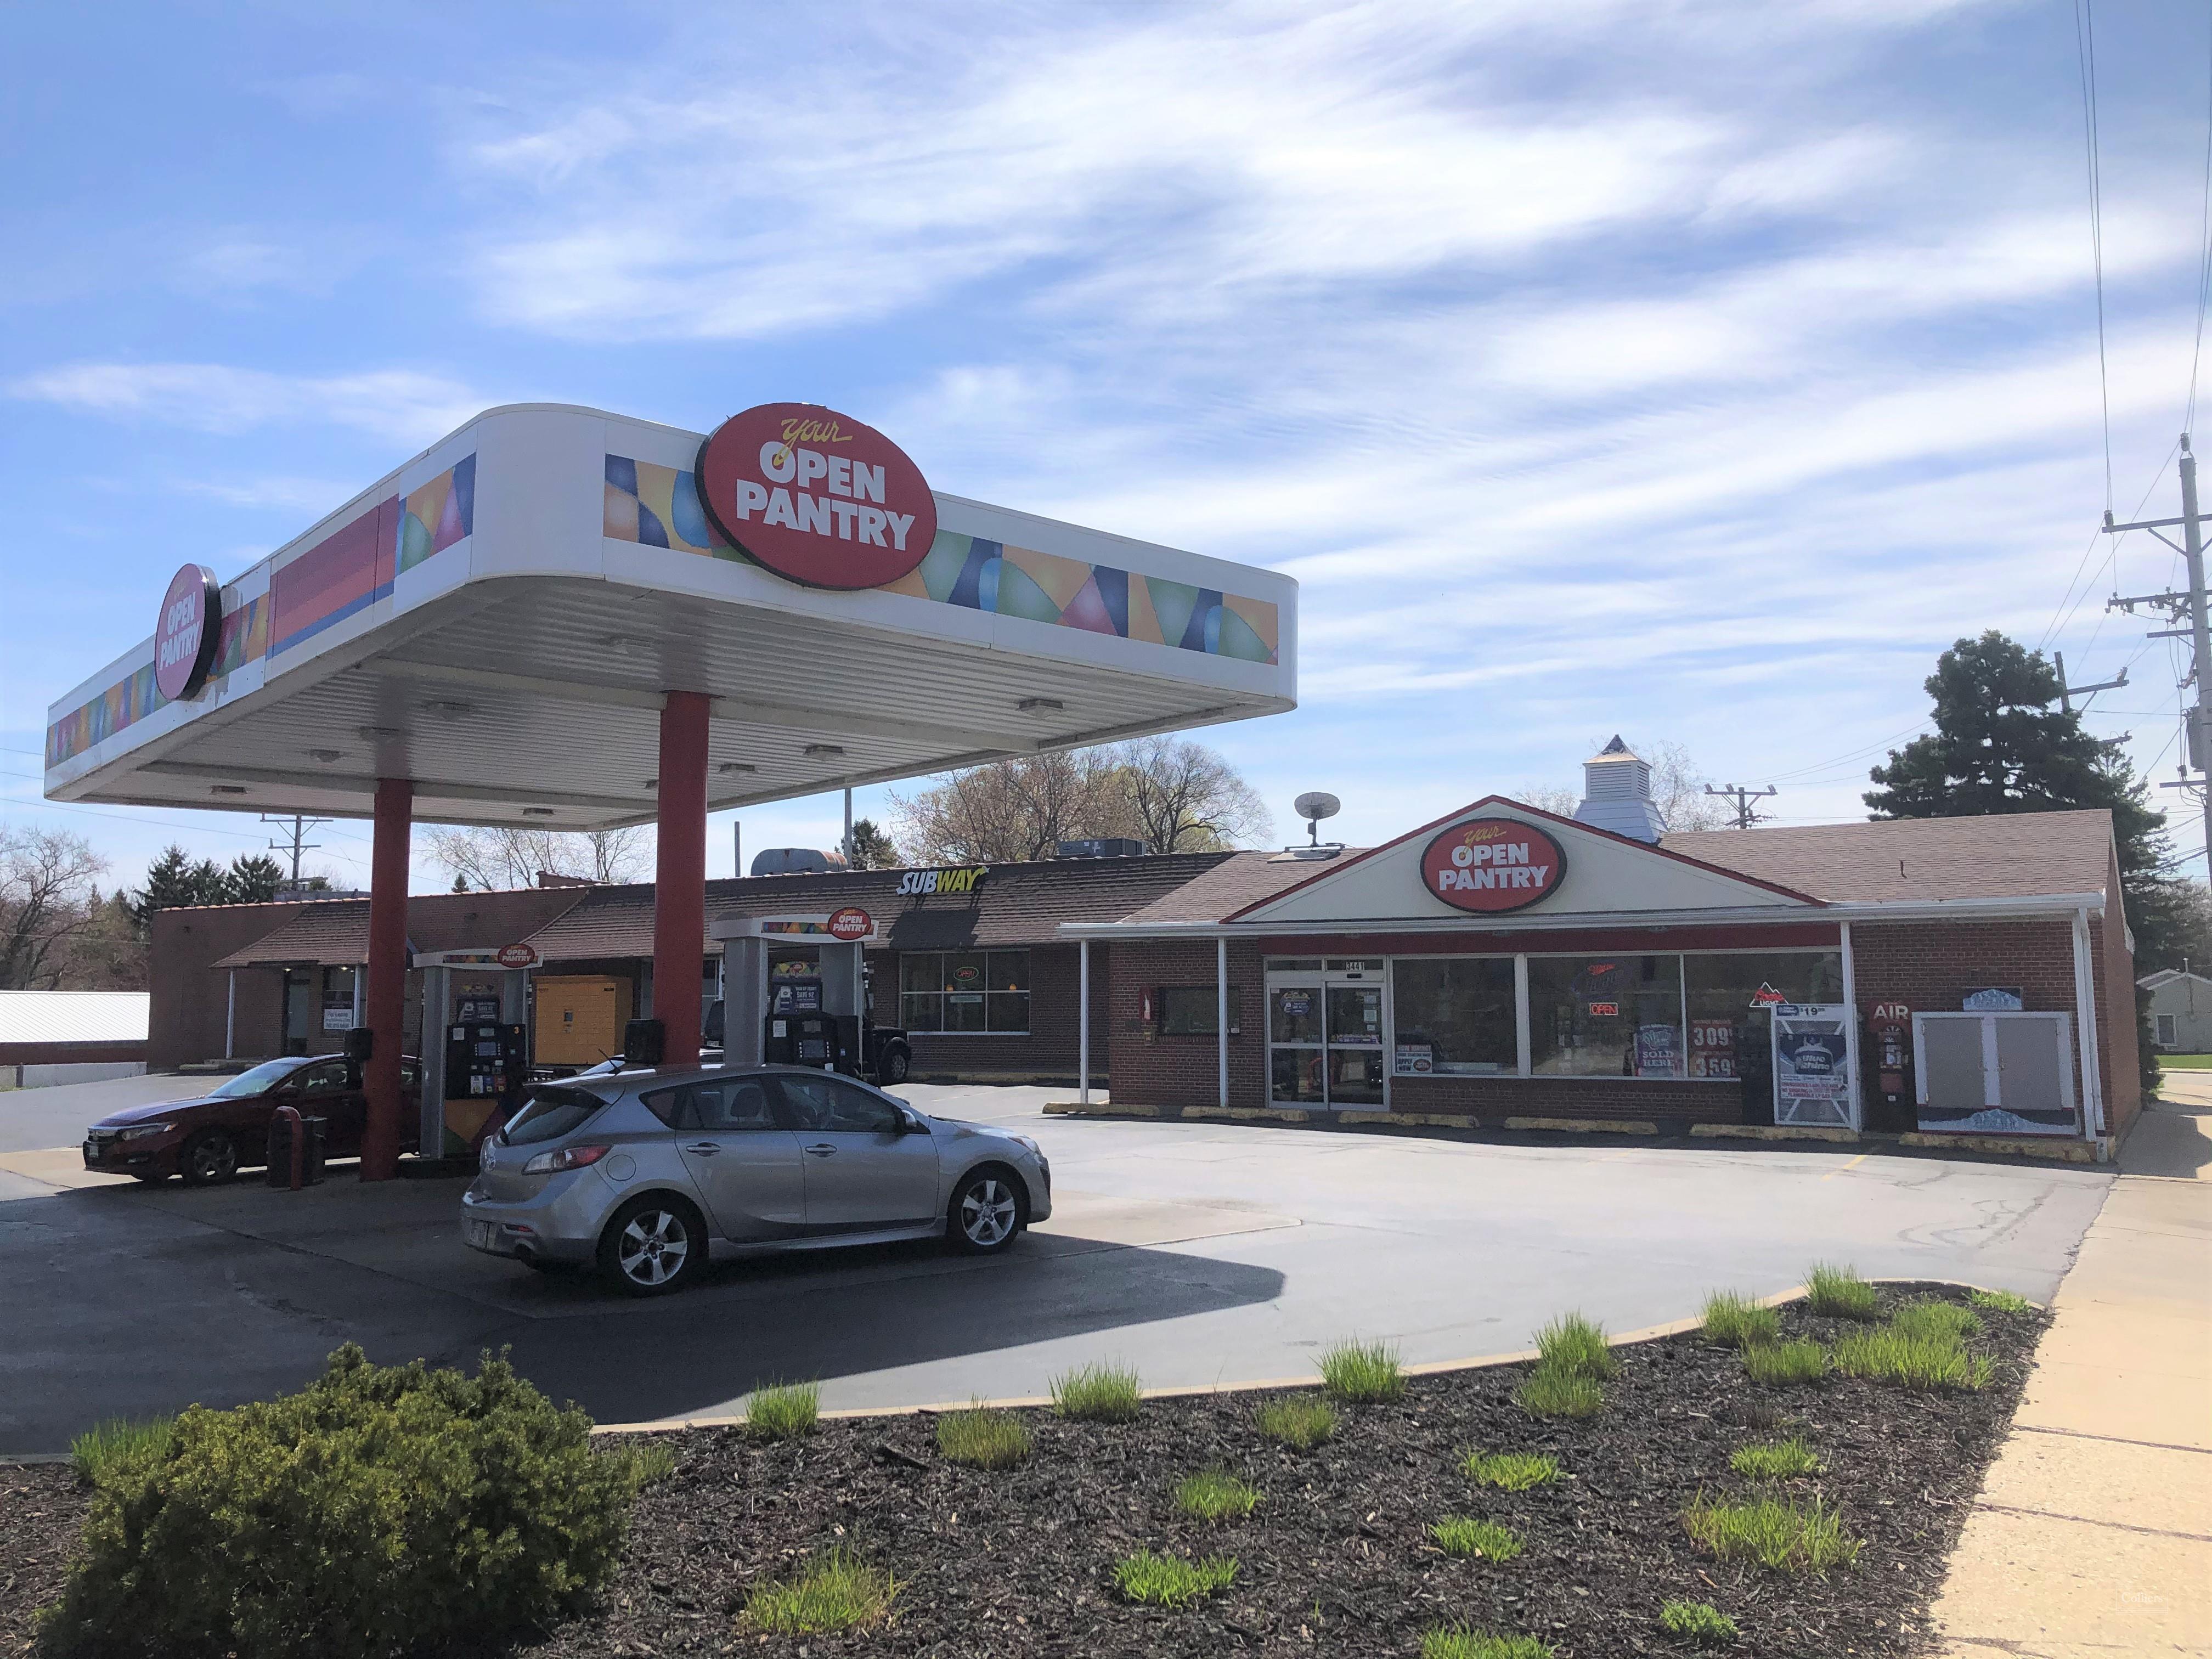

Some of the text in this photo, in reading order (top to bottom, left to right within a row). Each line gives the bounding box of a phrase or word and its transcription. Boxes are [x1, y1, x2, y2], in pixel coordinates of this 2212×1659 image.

[759, 441, 885, 504] OPEN
[736, 479, 916, 551] PANTRY
[167, 591, 196, 636] OPEN
[160, 620, 200, 670] PANTRY
[1452, 843, 1528, 867] OPEN
[896, 866, 990, 895] SUBWAY
[1439, 865, 1549, 890] PANTRY
[833, 923, 867, 932] PANTRY
[839, 915, 863, 923] OPEN
[1347, 962, 1364, 970] 3441
[1592, 1005, 1616, 1014] OPEN
[1874, 1005, 1909, 1020] AIR
